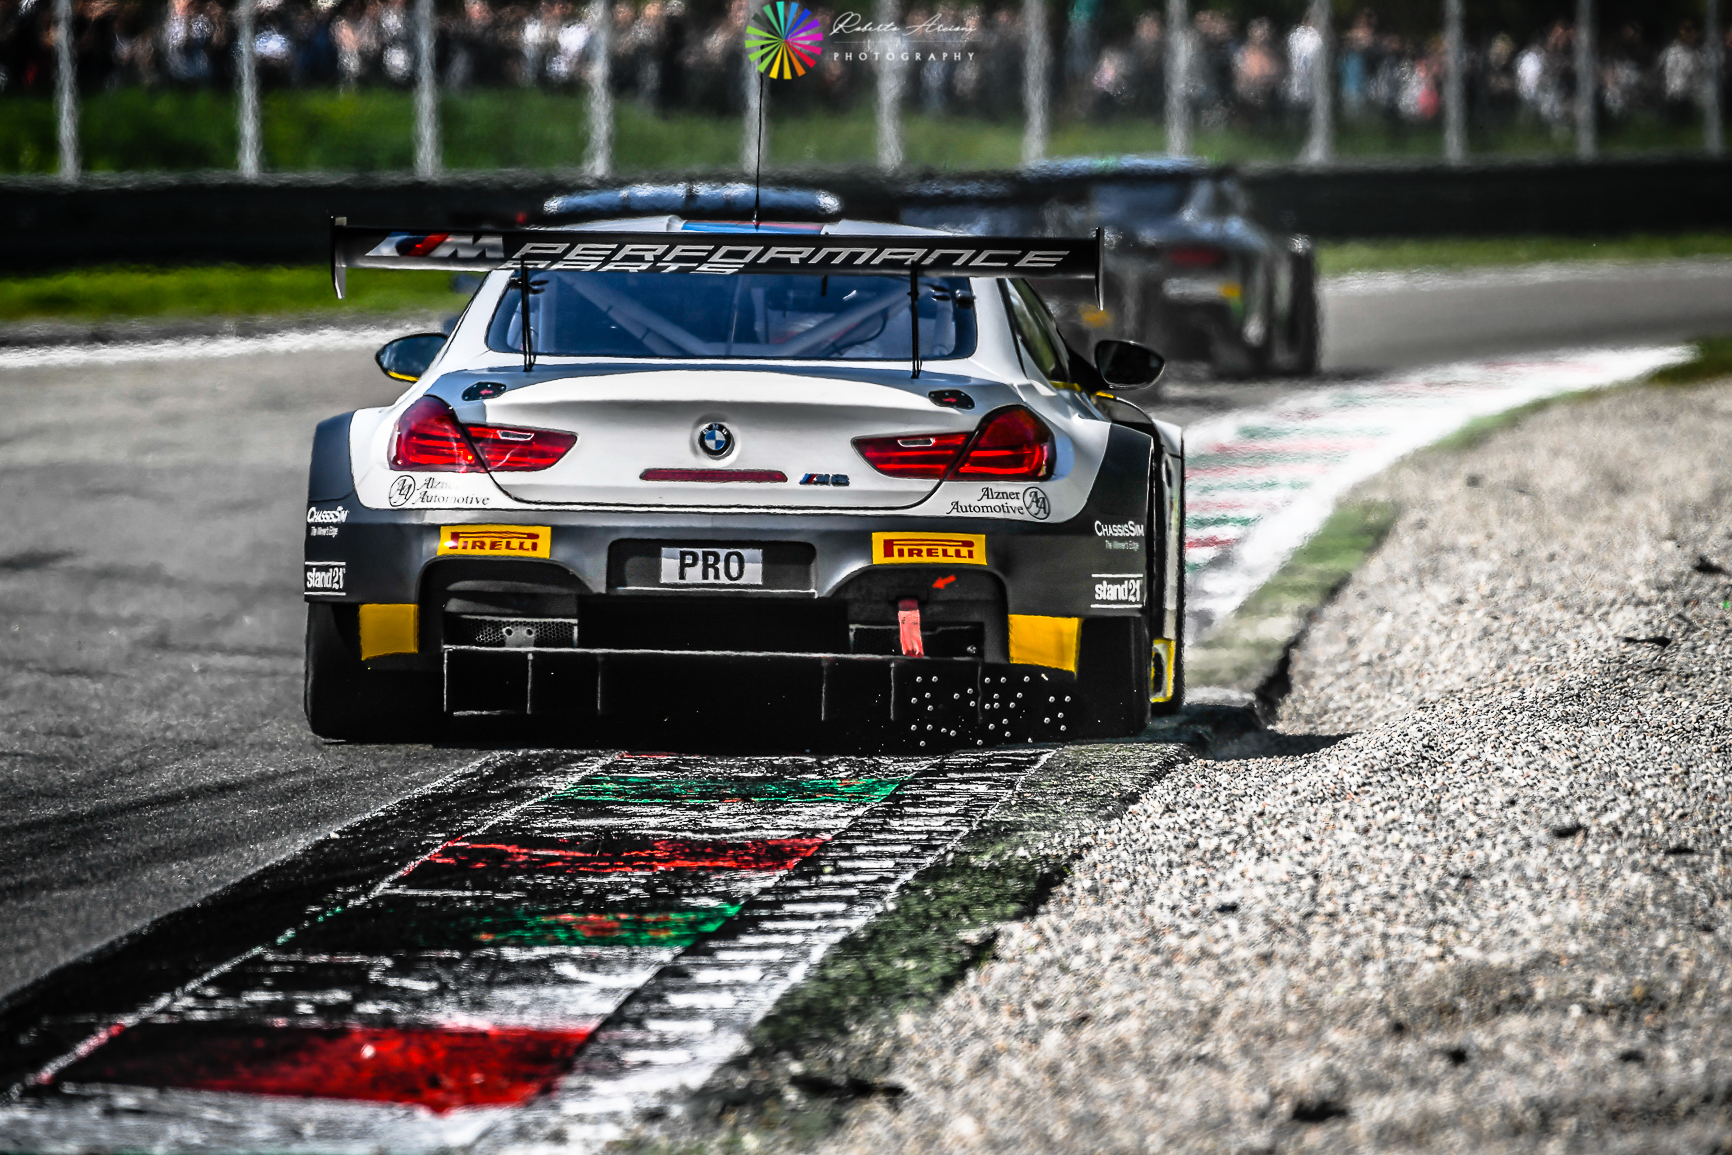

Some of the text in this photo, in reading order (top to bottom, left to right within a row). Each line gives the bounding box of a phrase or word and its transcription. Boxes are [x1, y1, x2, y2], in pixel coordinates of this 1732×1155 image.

[511, 243, 1070, 267] PERFORMANCE
[498, 260, 745, 275] PARTS
[977, 487, 1021, 501] Alzner
[946, 501, 1024, 515] Automotive
[448, 531, 539, 553] PIRELLI
[883, 538, 975, 559] PIRELLI
[678, 550, 745, 581] PRO
[306, 567, 344, 590] stand21
[1094, 579, 1140, 602] stand21
